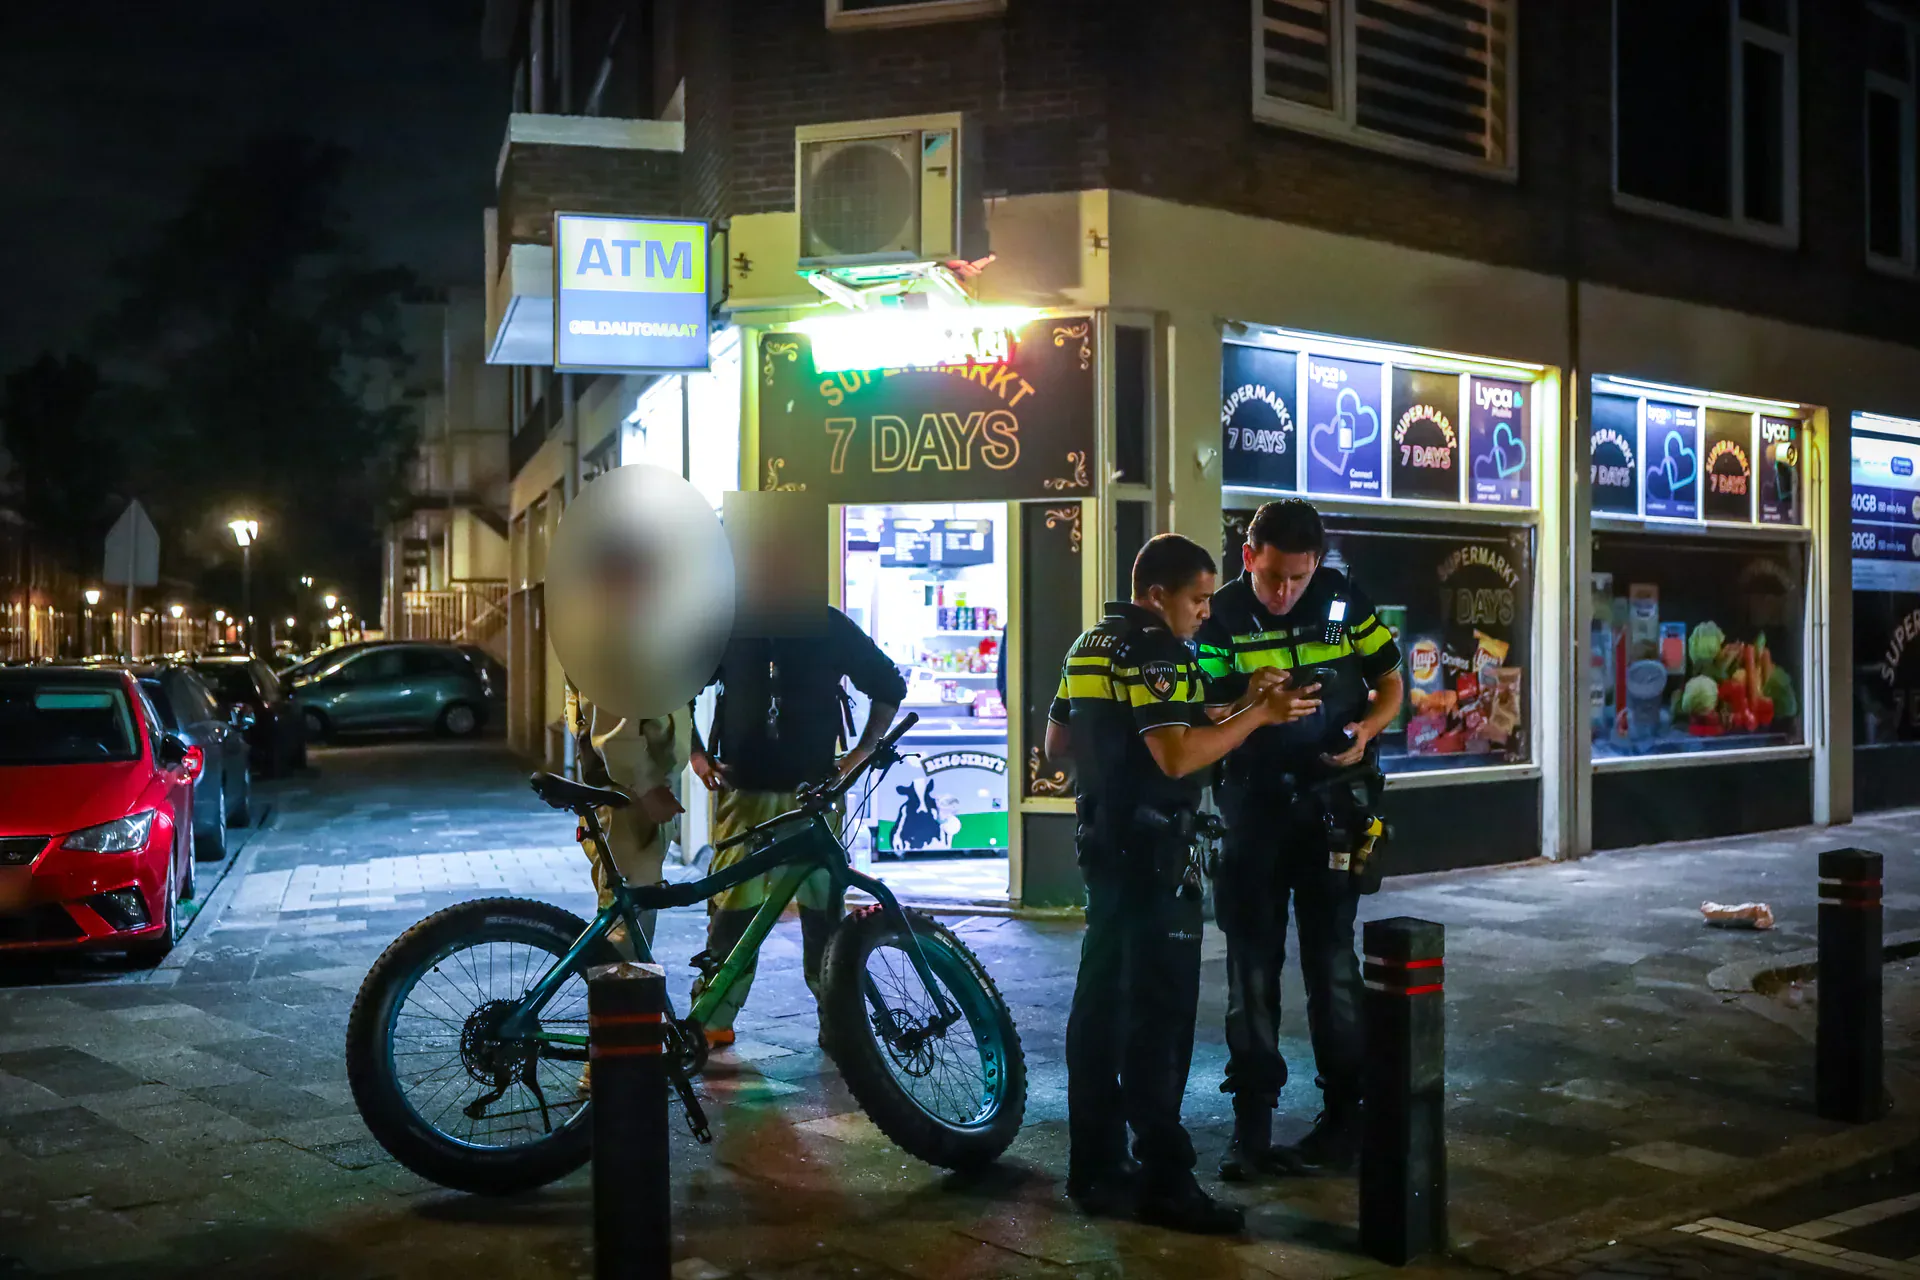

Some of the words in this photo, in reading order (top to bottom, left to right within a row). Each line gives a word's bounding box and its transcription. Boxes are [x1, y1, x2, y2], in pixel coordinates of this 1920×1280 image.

[576, 238, 692, 279] ATM
[569, 320, 699, 337] GELDAUTOMAAT
[1309, 361, 1339, 383] Lyca
[1220, 383, 1294, 432] SUPERMARKT
[1475, 381, 1513, 410] Lyca
[1394, 404, 1457, 448] SUPERMARKT
[1762, 418, 1790, 443] Lyca
[824, 417, 857, 474] 7
[871, 410, 1020, 473] DAYS
[1227, 427, 1240, 450] 7
[1242, 427, 1287, 455] DAYS
[1400, 445, 1411, 467] 7
[1413, 445, 1451, 470] DAYS
[1706, 439, 1751, 477] SUPERMARKT
[1598, 465, 1631, 488] DAYS
[1710, 474, 1718, 493] 7
[1719, 474, 1747, 496] DAYS
[1436, 545, 1519, 589] SUPERMARKT
[1456, 588, 1515, 627] DAYS
